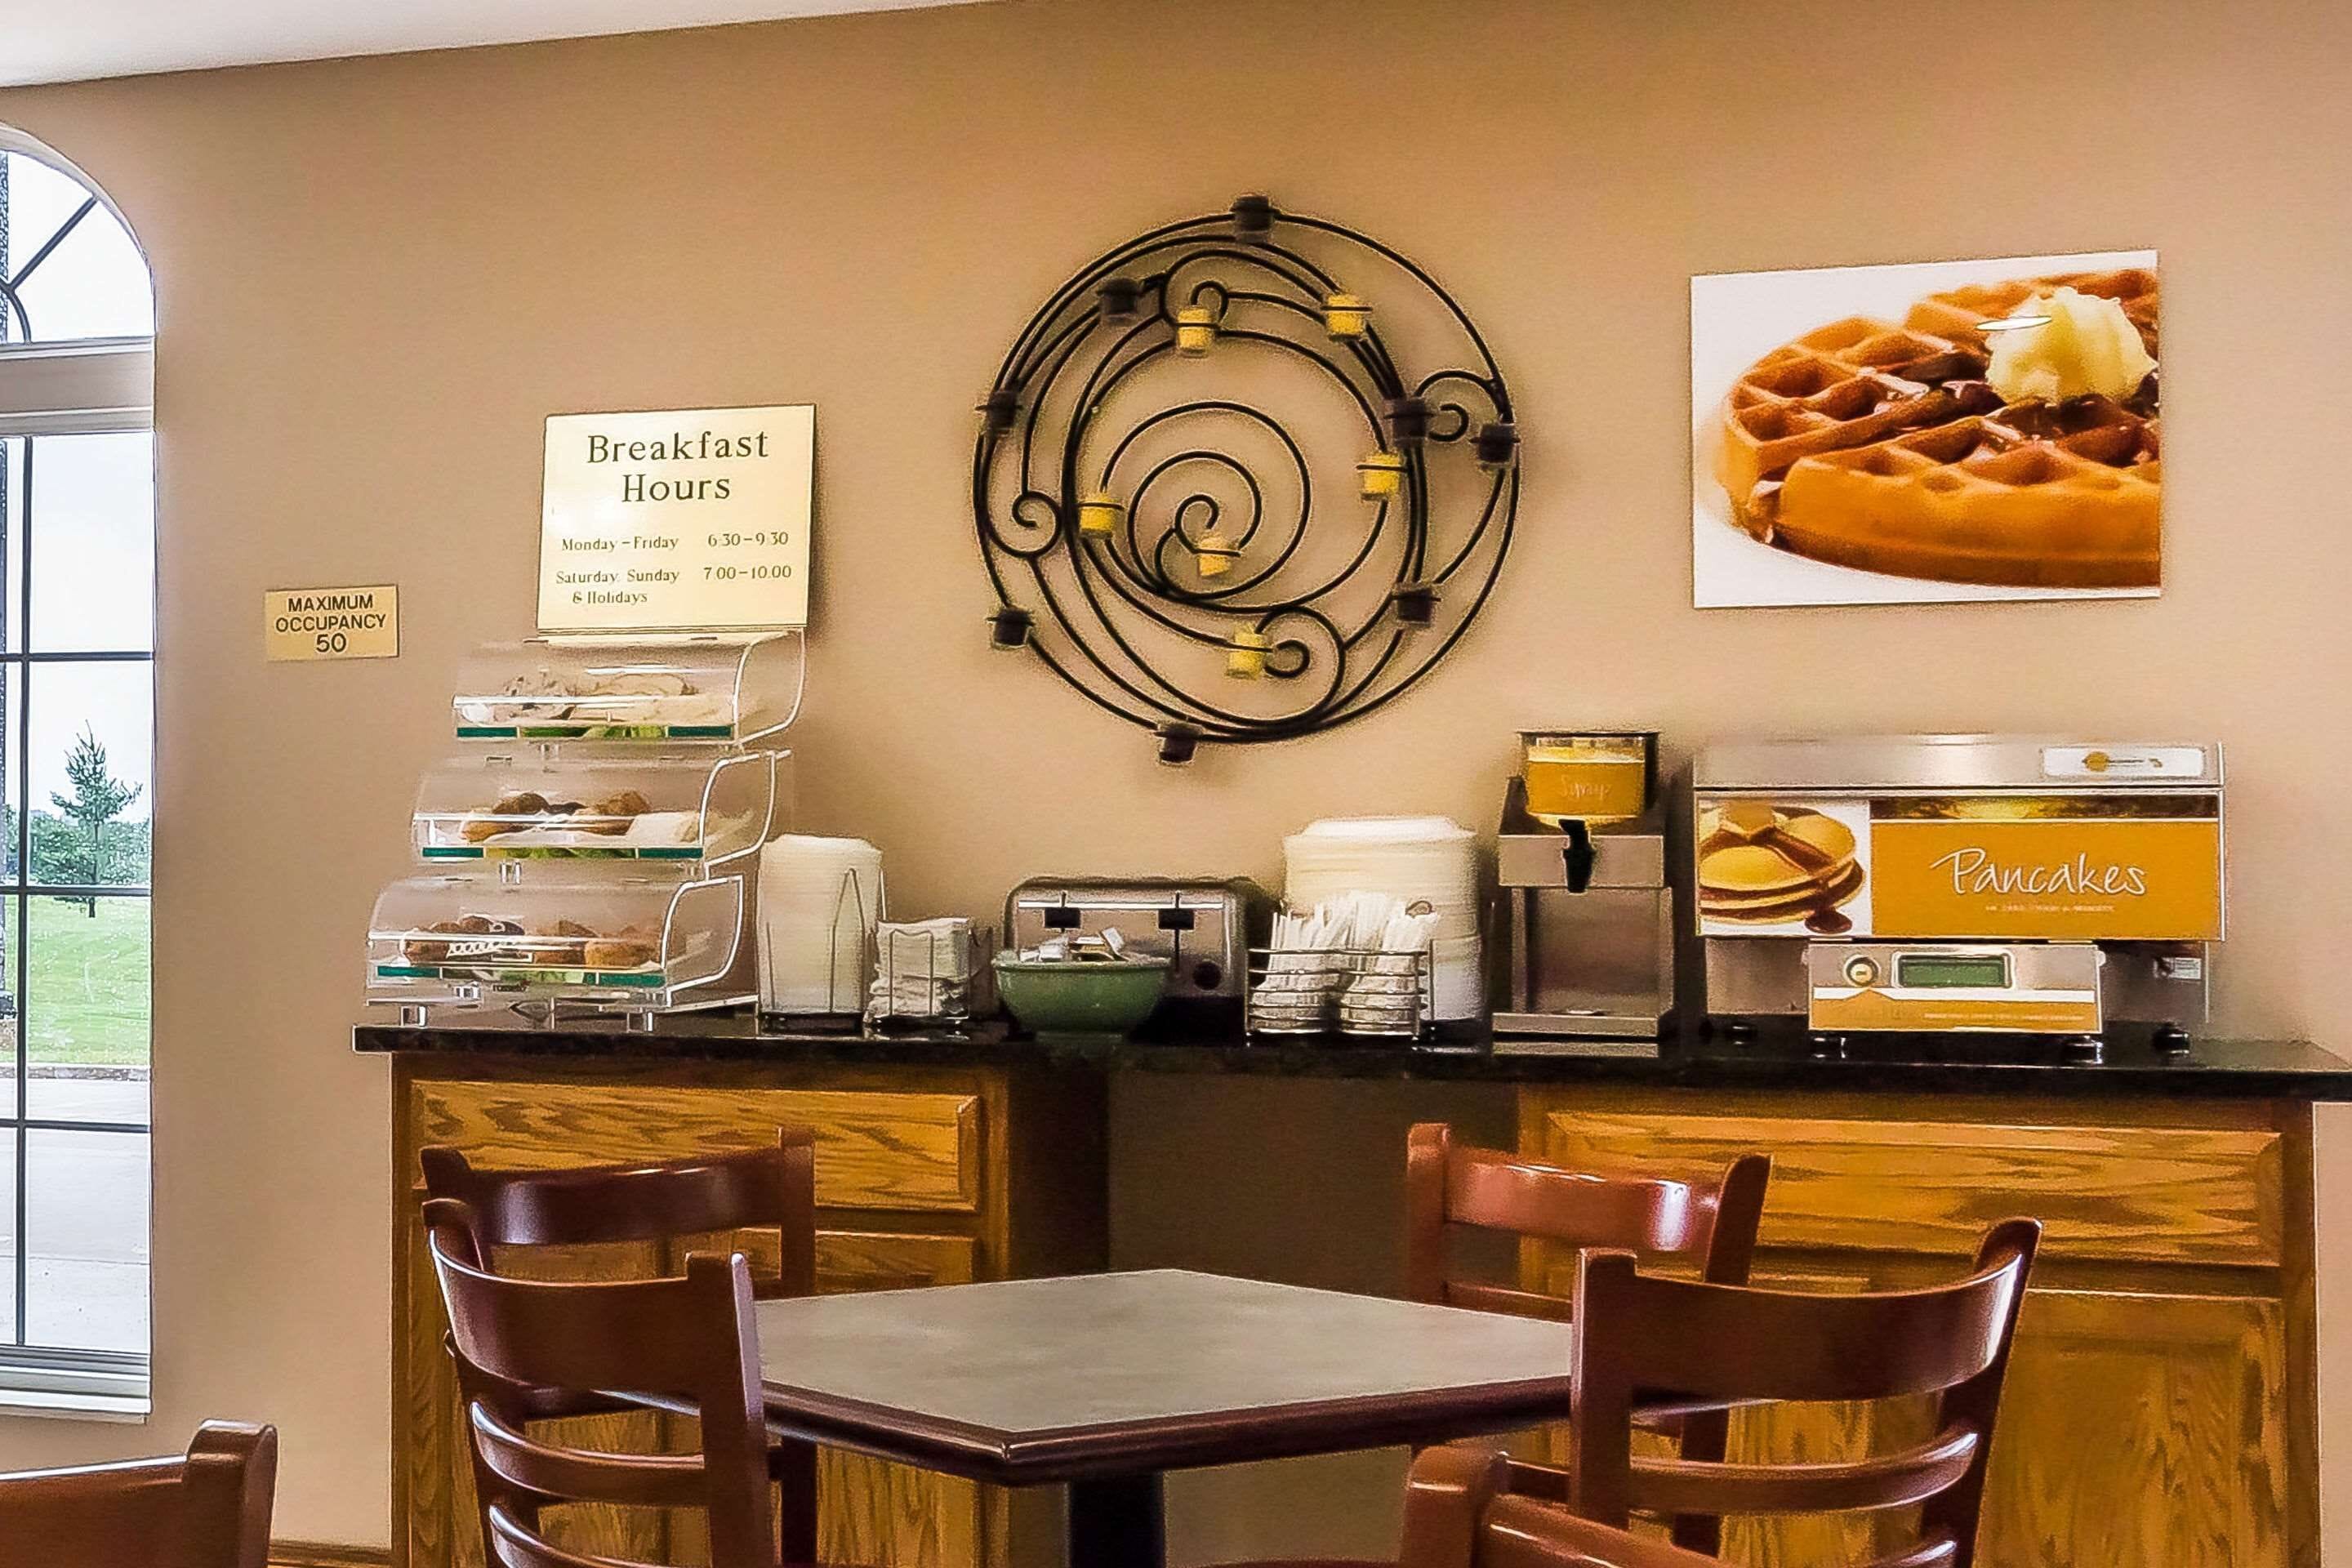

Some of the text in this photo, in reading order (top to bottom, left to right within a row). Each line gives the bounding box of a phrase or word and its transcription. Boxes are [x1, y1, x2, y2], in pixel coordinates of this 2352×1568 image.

[586, 430, 770, 464] Breakfast
[621, 474, 731, 503] Hours
[562, 537, 617, 553] Monday
[634, 536, 679, 551] Friday
[627, 568, 679, 585] Sunday
[287, 594, 373, 612] MAXIMUM
[572, 590, 648, 605] & Holidays
[275, 613, 386, 632] OCCUPANCY
[316, 633, 347, 653] 50
[1930, 848, 2146, 895] Pancakes
